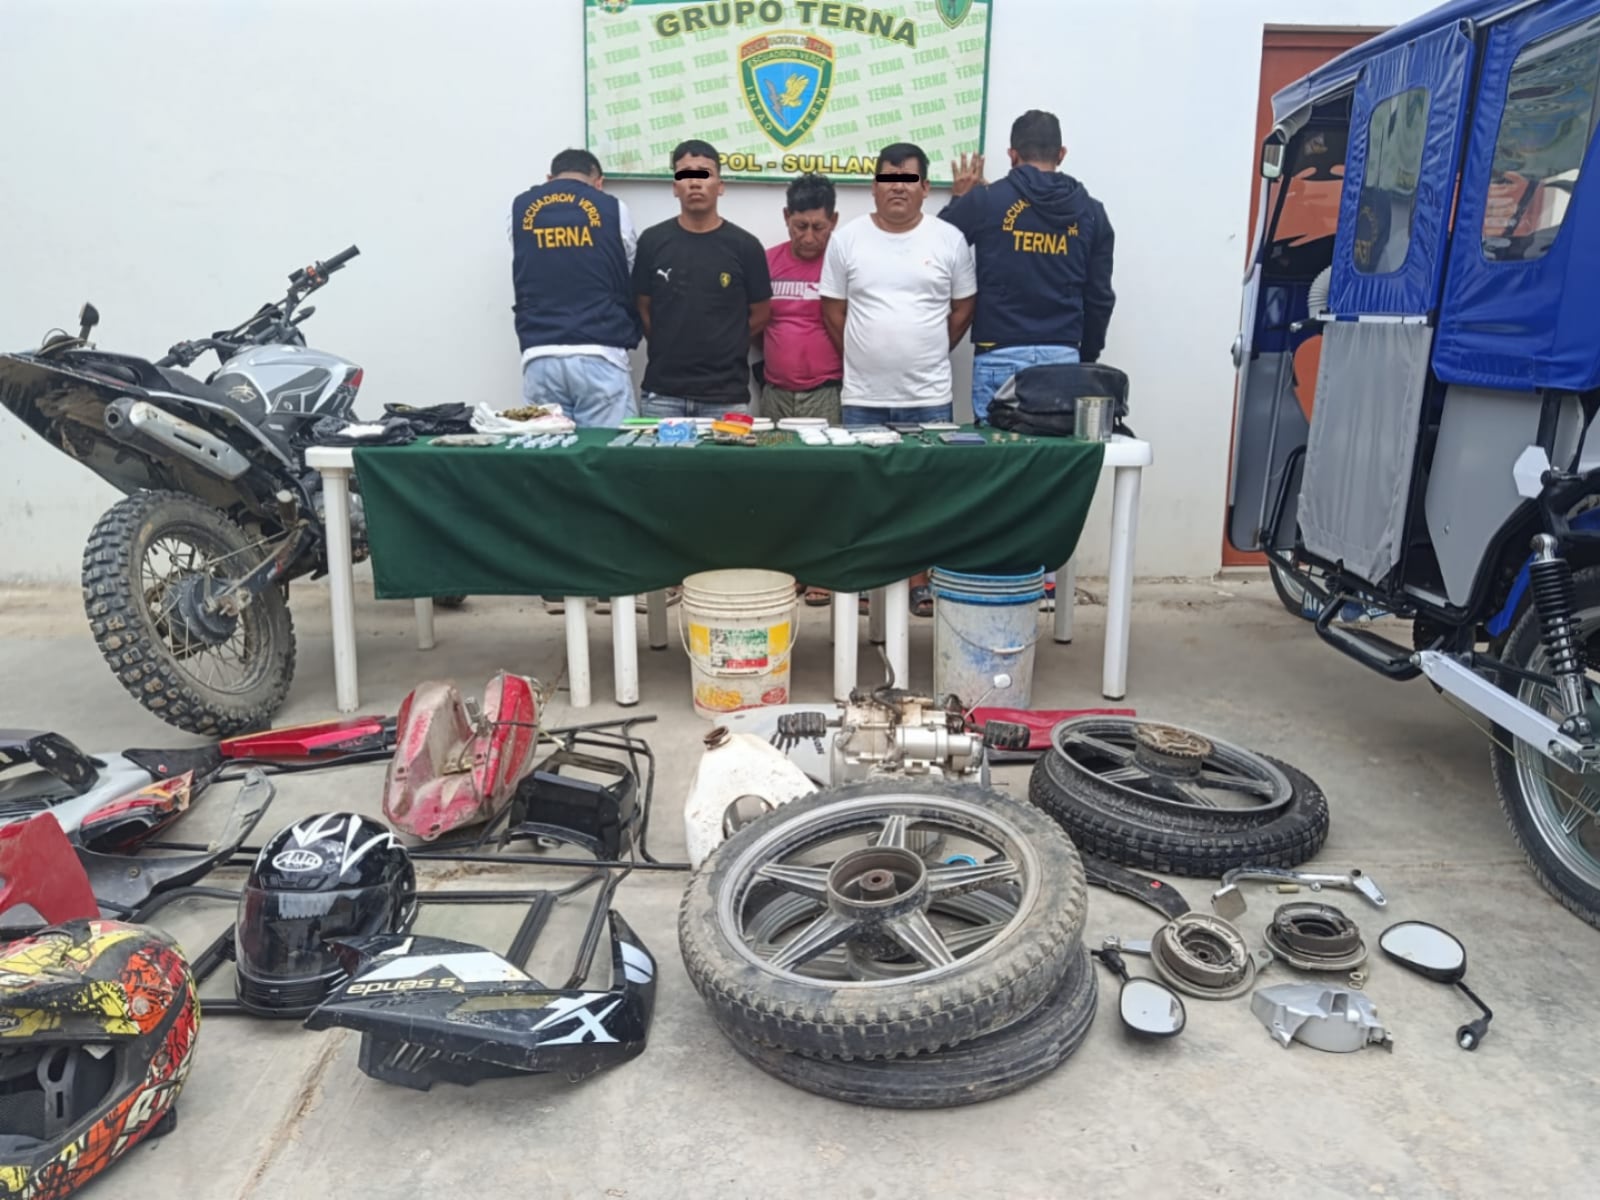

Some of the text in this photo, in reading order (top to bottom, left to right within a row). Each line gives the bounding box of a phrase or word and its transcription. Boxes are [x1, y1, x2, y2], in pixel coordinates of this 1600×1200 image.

[655, 0, 783, 37] GRUPO
[796, 1, 916, 48] TERNA
[782, 154, 878, 174] SULLAN
[523, 193, 601, 230] ESCUADRON VERDE
[533, 226, 594, 249] TERNA
[1012, 230, 1068, 255] TERNA
[771, 281, 804, 295] UMA
